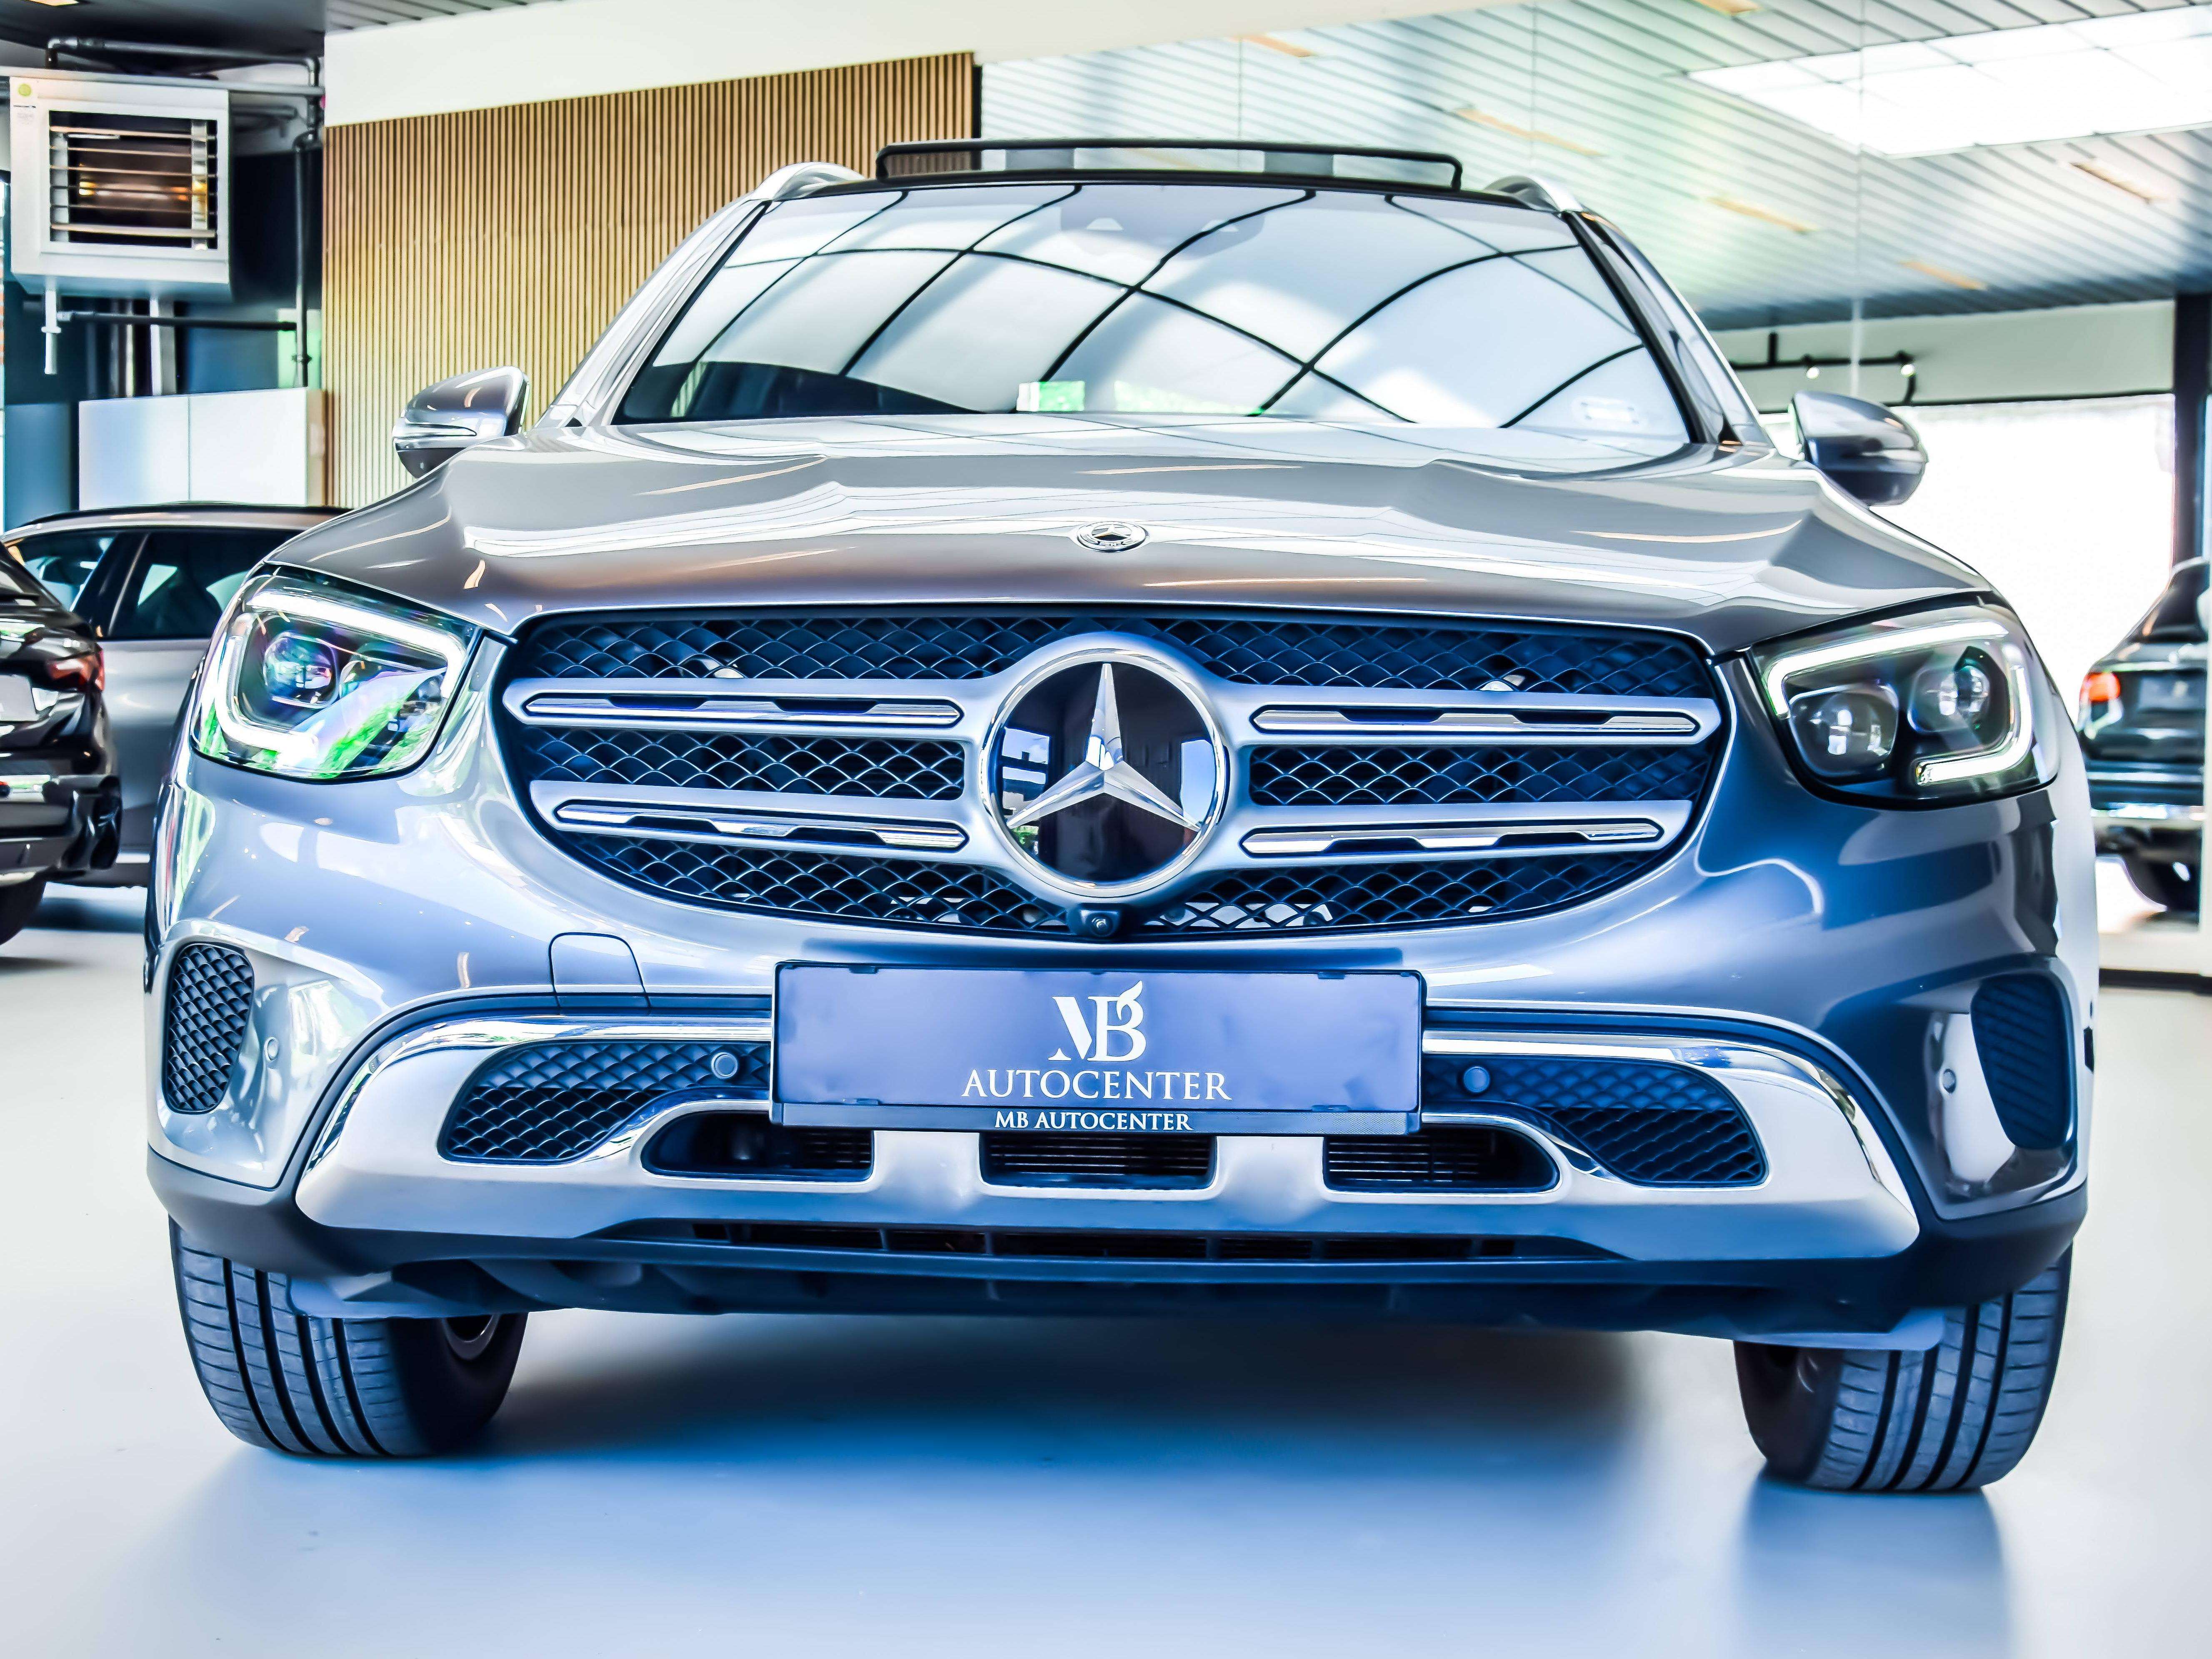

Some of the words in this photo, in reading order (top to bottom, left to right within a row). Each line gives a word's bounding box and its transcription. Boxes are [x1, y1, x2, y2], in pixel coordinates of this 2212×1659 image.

[1048, 980, 1146, 1061] MB
[961, 1069, 1232, 1100] AUTOCENTER
[994, 1111, 1029, 1128] MB
[1034, 1111, 1193, 1130] AUTOCENTER
